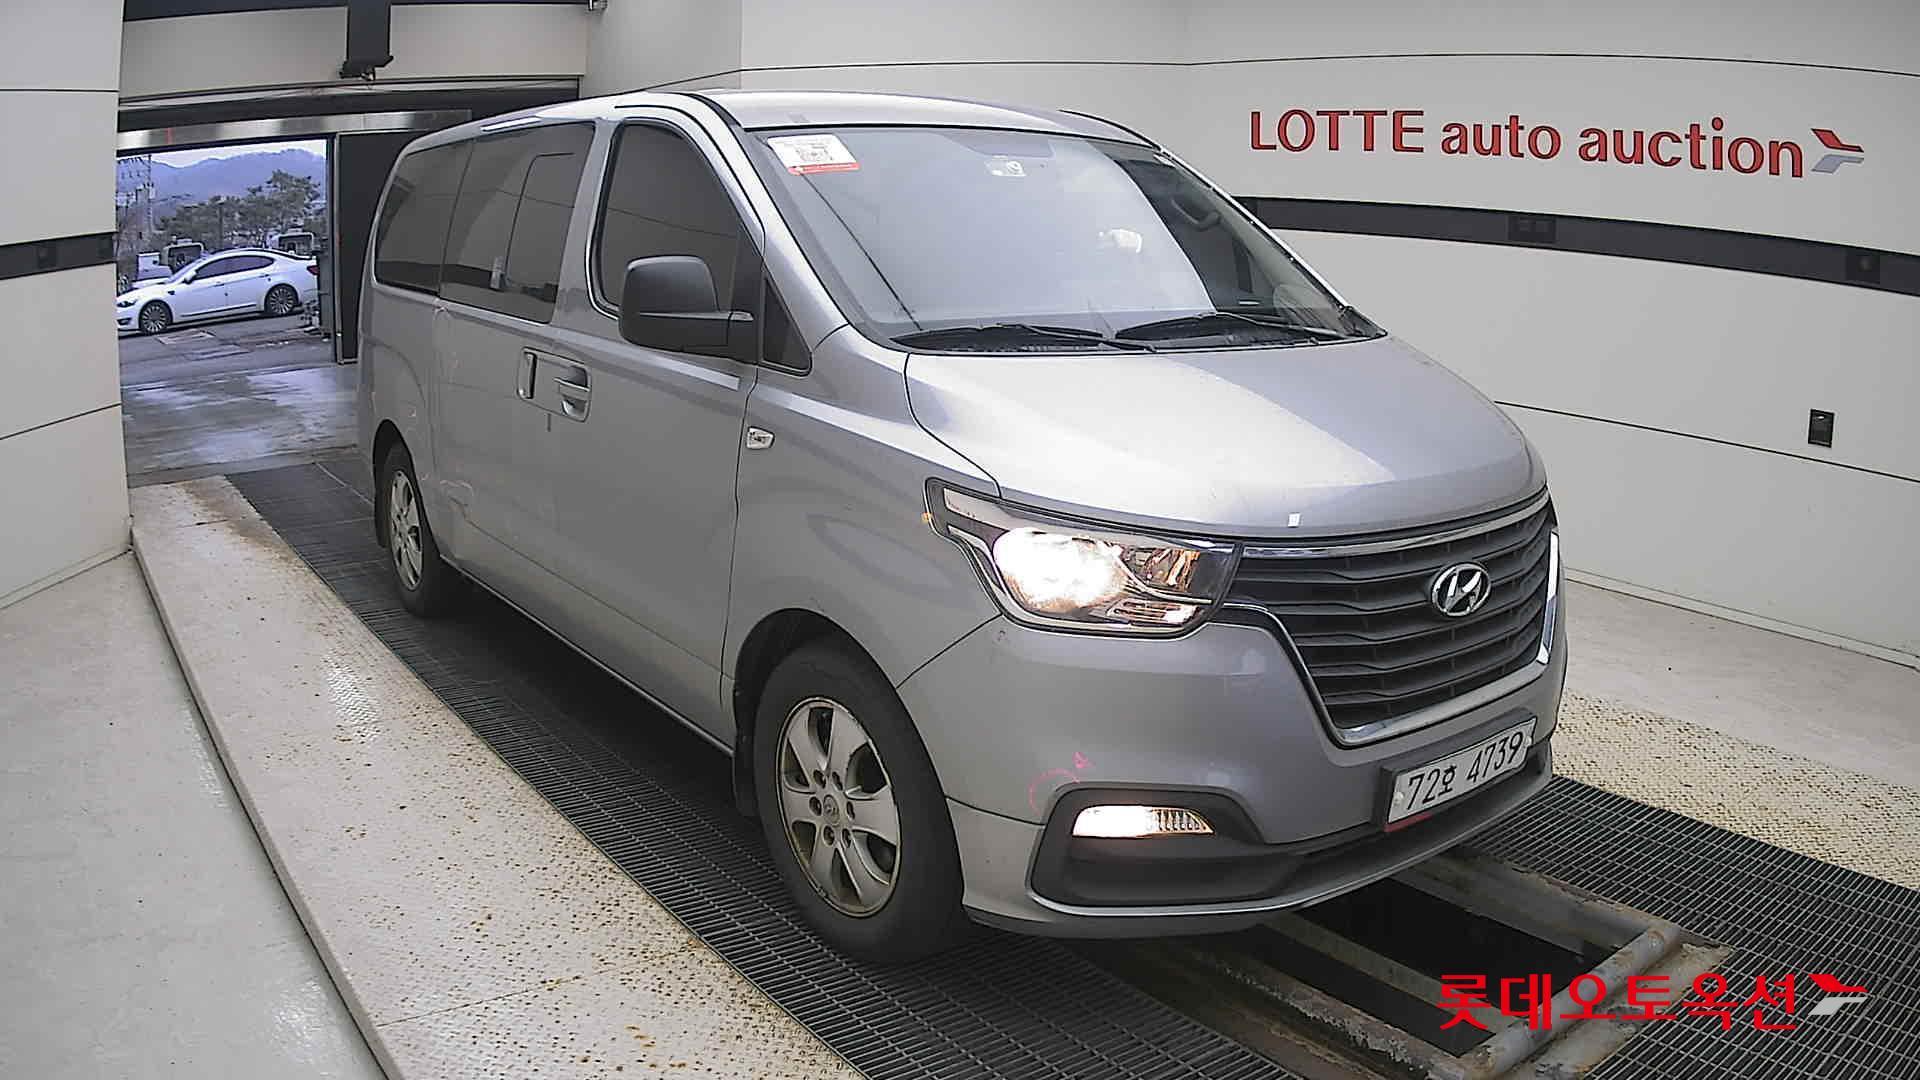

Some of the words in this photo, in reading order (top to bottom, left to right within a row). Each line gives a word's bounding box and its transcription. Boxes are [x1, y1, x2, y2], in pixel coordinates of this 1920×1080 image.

[1250, 108, 1426, 154] LOTTE
[1440, 114, 1563, 161] auto
[1577, 116, 1805, 179] auction
[1406, 763, 1457, 811] 72호
[1466, 731, 1524, 784] 4739
